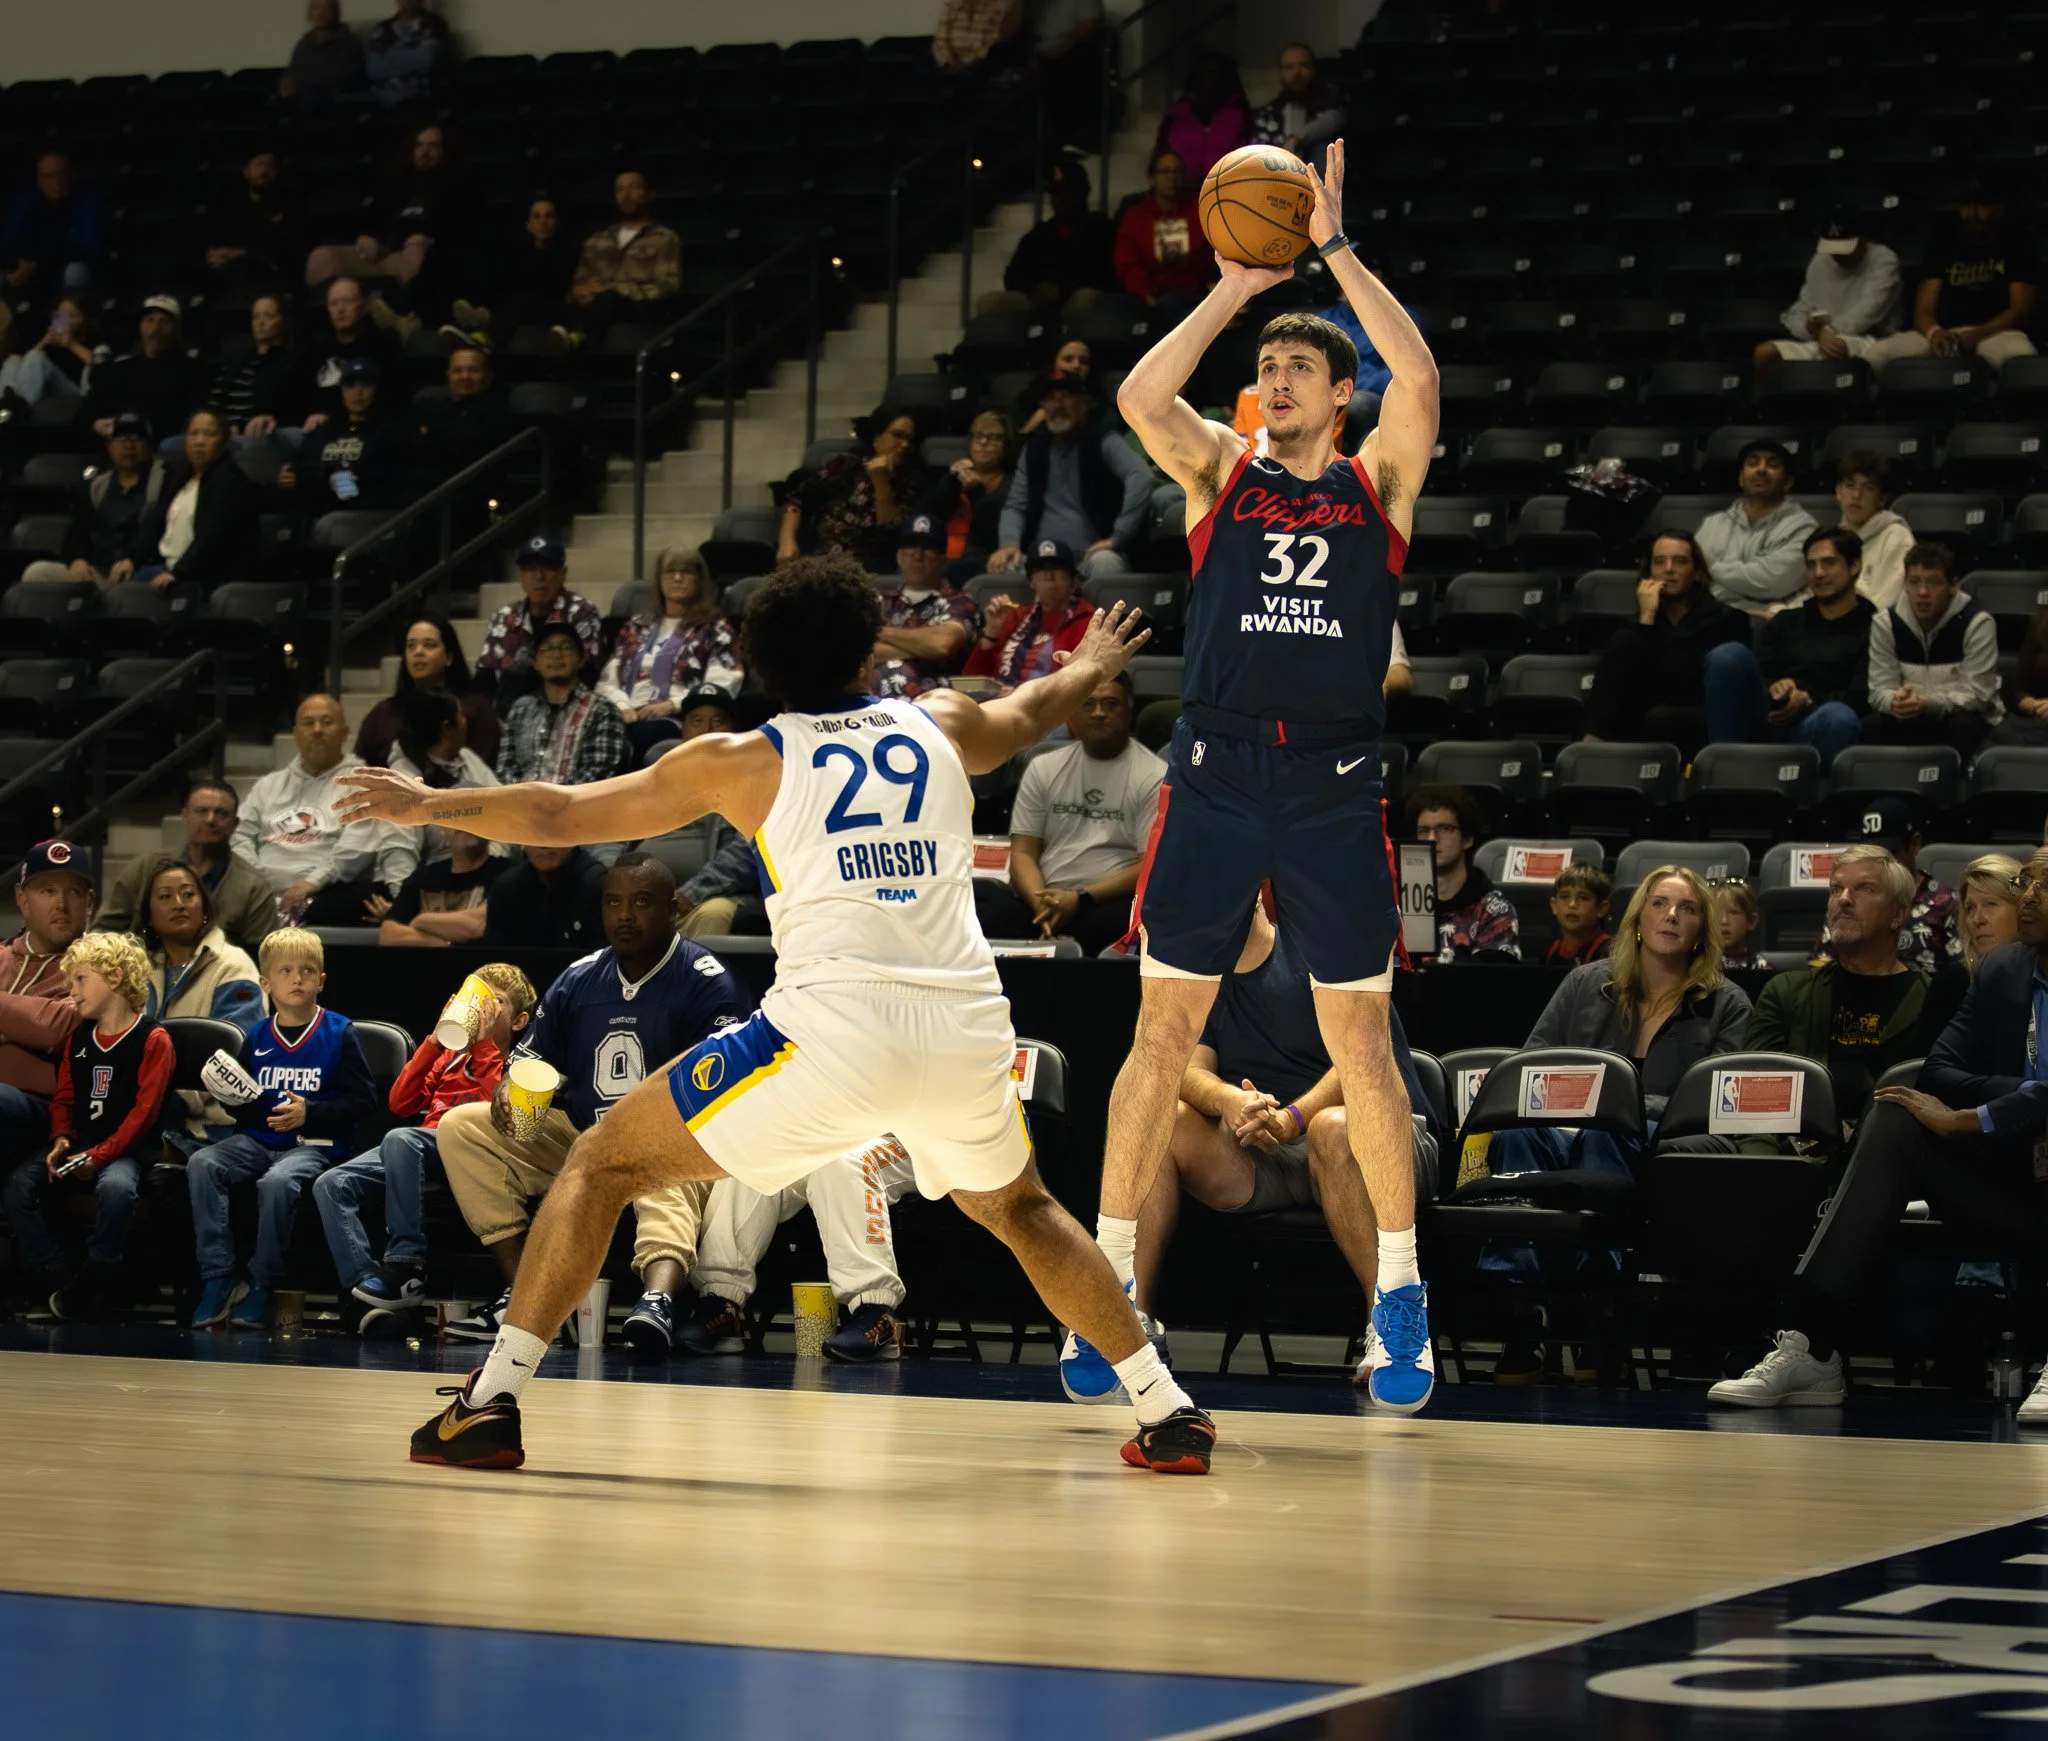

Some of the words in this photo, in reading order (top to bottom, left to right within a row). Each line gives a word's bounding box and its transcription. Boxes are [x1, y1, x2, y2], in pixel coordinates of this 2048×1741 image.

[1233, 486, 1368, 533] Clippers
[1260, 532, 1330, 588] 32
[1262, 595, 1323, 616] VISIT
[1240, 614, 1343, 638] RWANDA
[812, 733, 929, 834] 29
[1861, 811, 1883, 835] SD
[837, 840, 937, 882] GRIGSBY
[876, 889, 917, 903] TEAM
[1401, 883, 1435, 913] 106
[208, 1056, 257, 1102] FRONT
[257, 1066, 321, 1092] CLIPPERS
